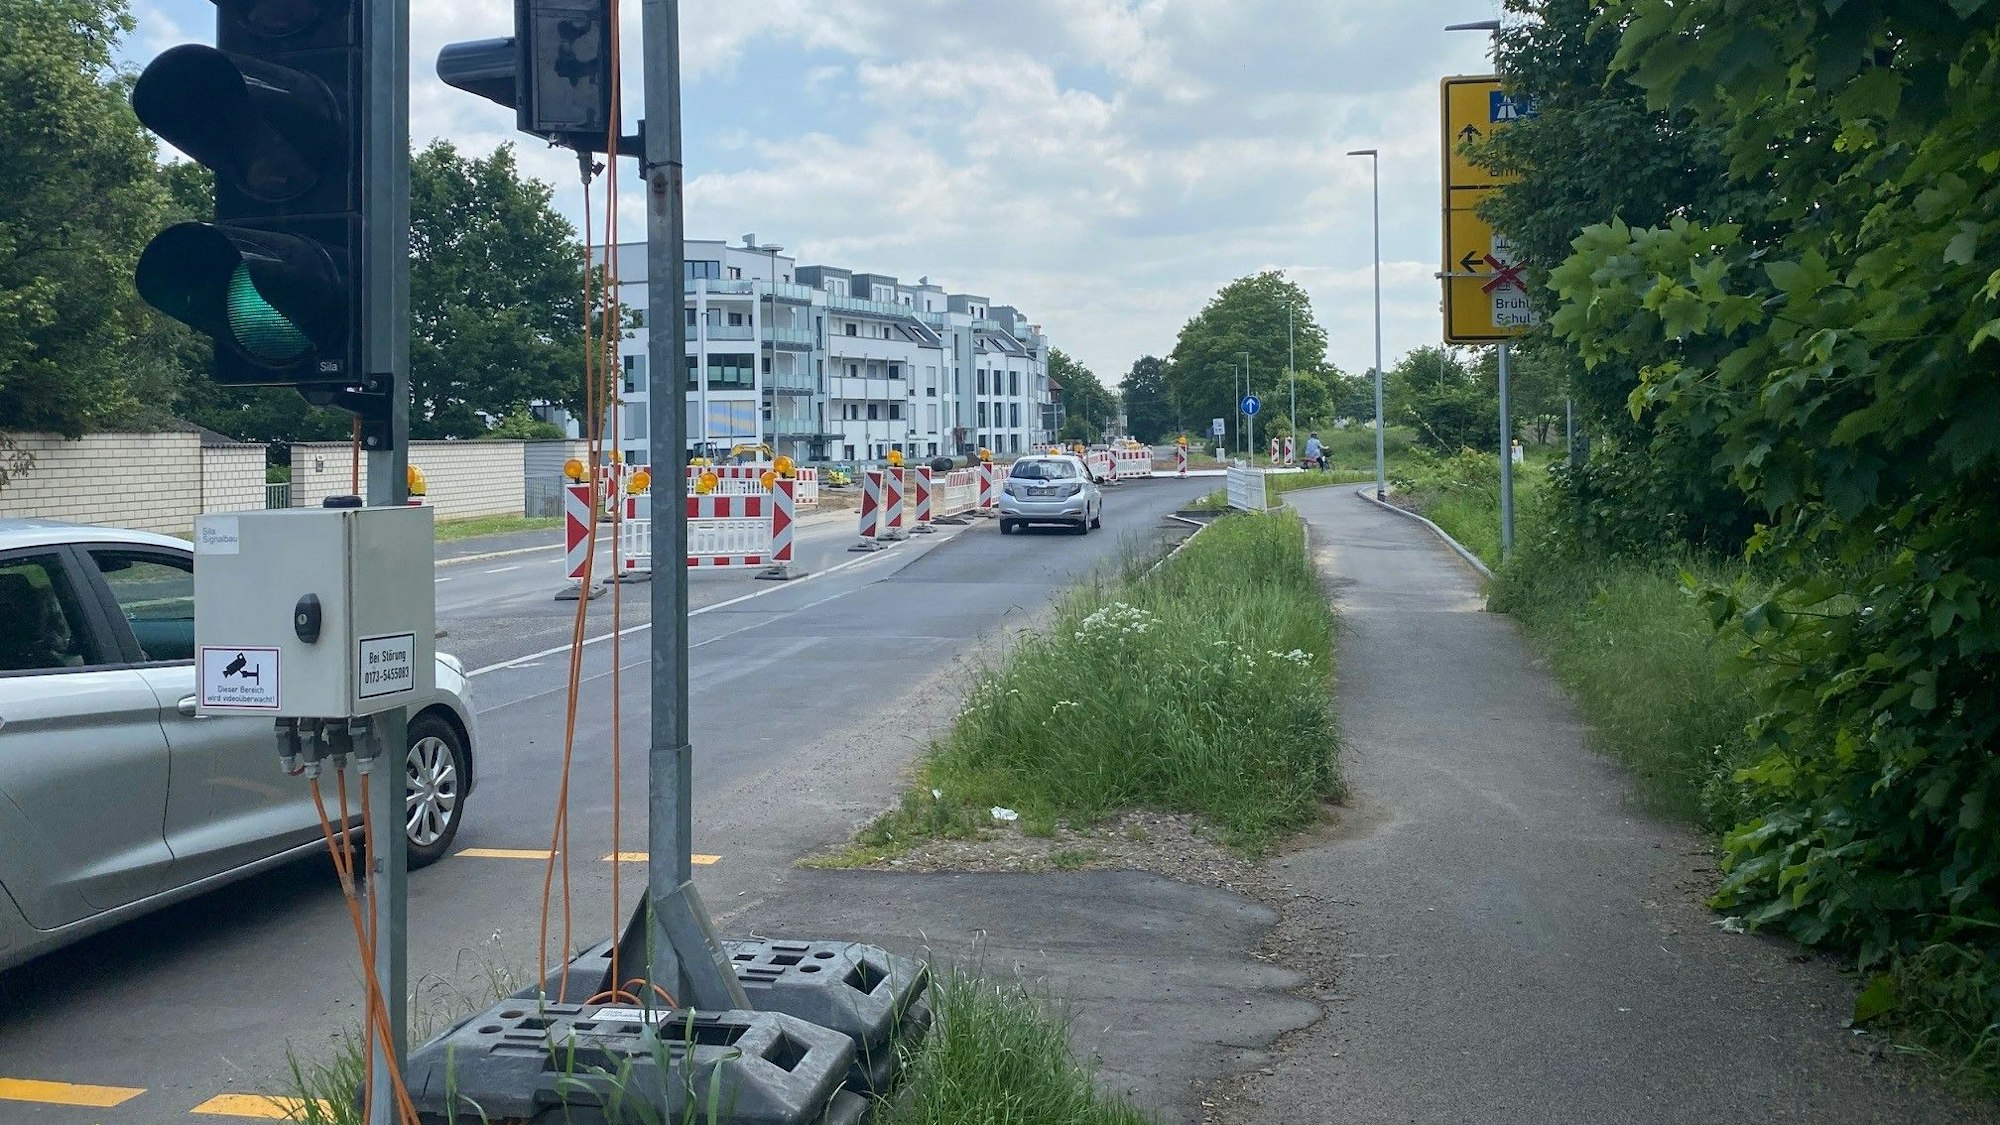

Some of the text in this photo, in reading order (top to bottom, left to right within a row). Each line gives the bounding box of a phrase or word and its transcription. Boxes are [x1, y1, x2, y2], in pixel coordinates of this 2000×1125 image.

[369, 649, 406, 664] Bei Störung
[217, 685, 264, 693] Dieser Bereich
